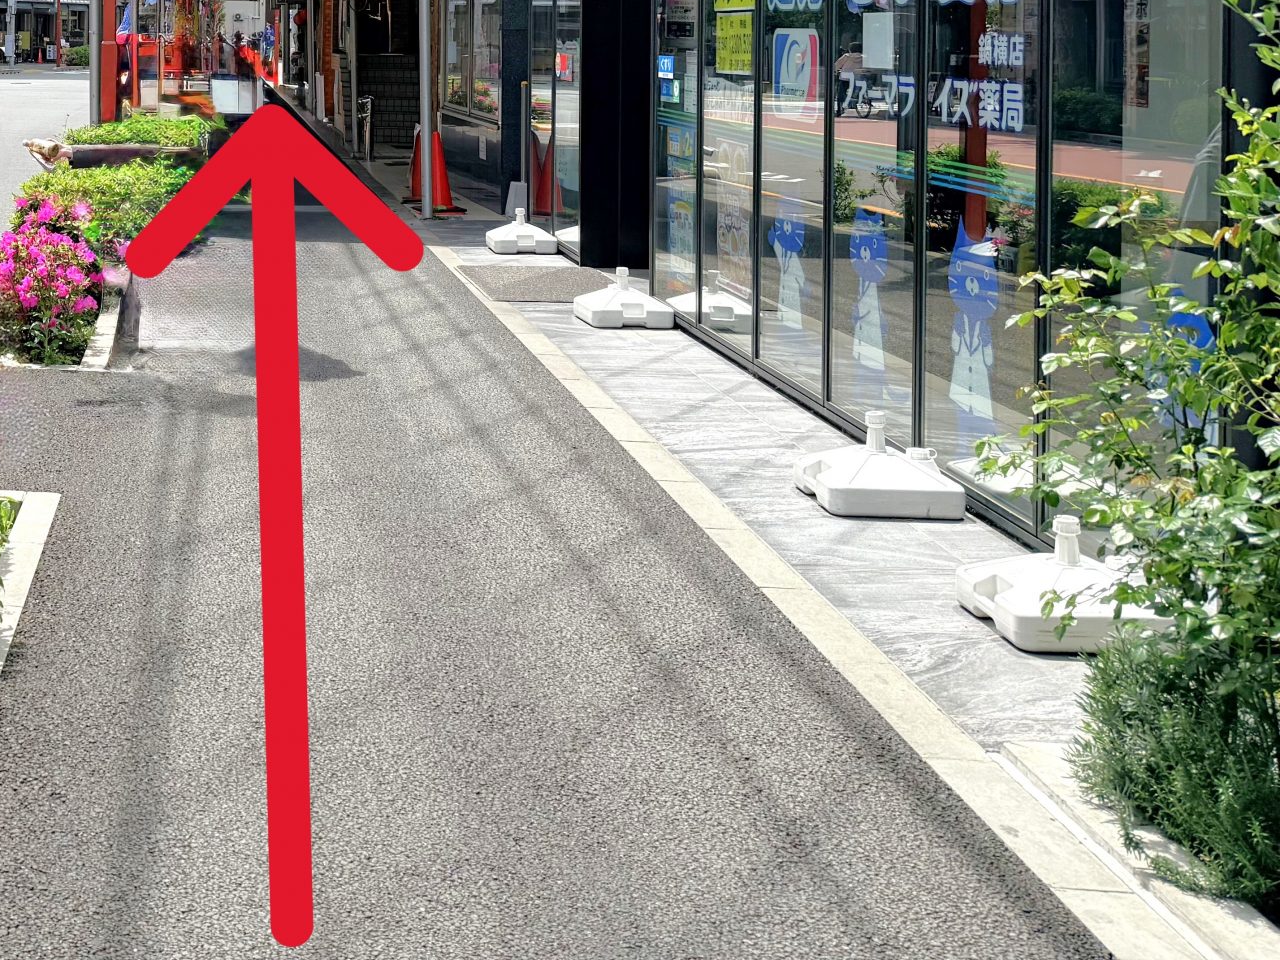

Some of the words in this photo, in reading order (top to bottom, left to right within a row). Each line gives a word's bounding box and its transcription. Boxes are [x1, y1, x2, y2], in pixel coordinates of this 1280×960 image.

[977, 33, 1025, 67] 鍋横店
[838, 71, 1024, 132] ファーマライズ薬局
